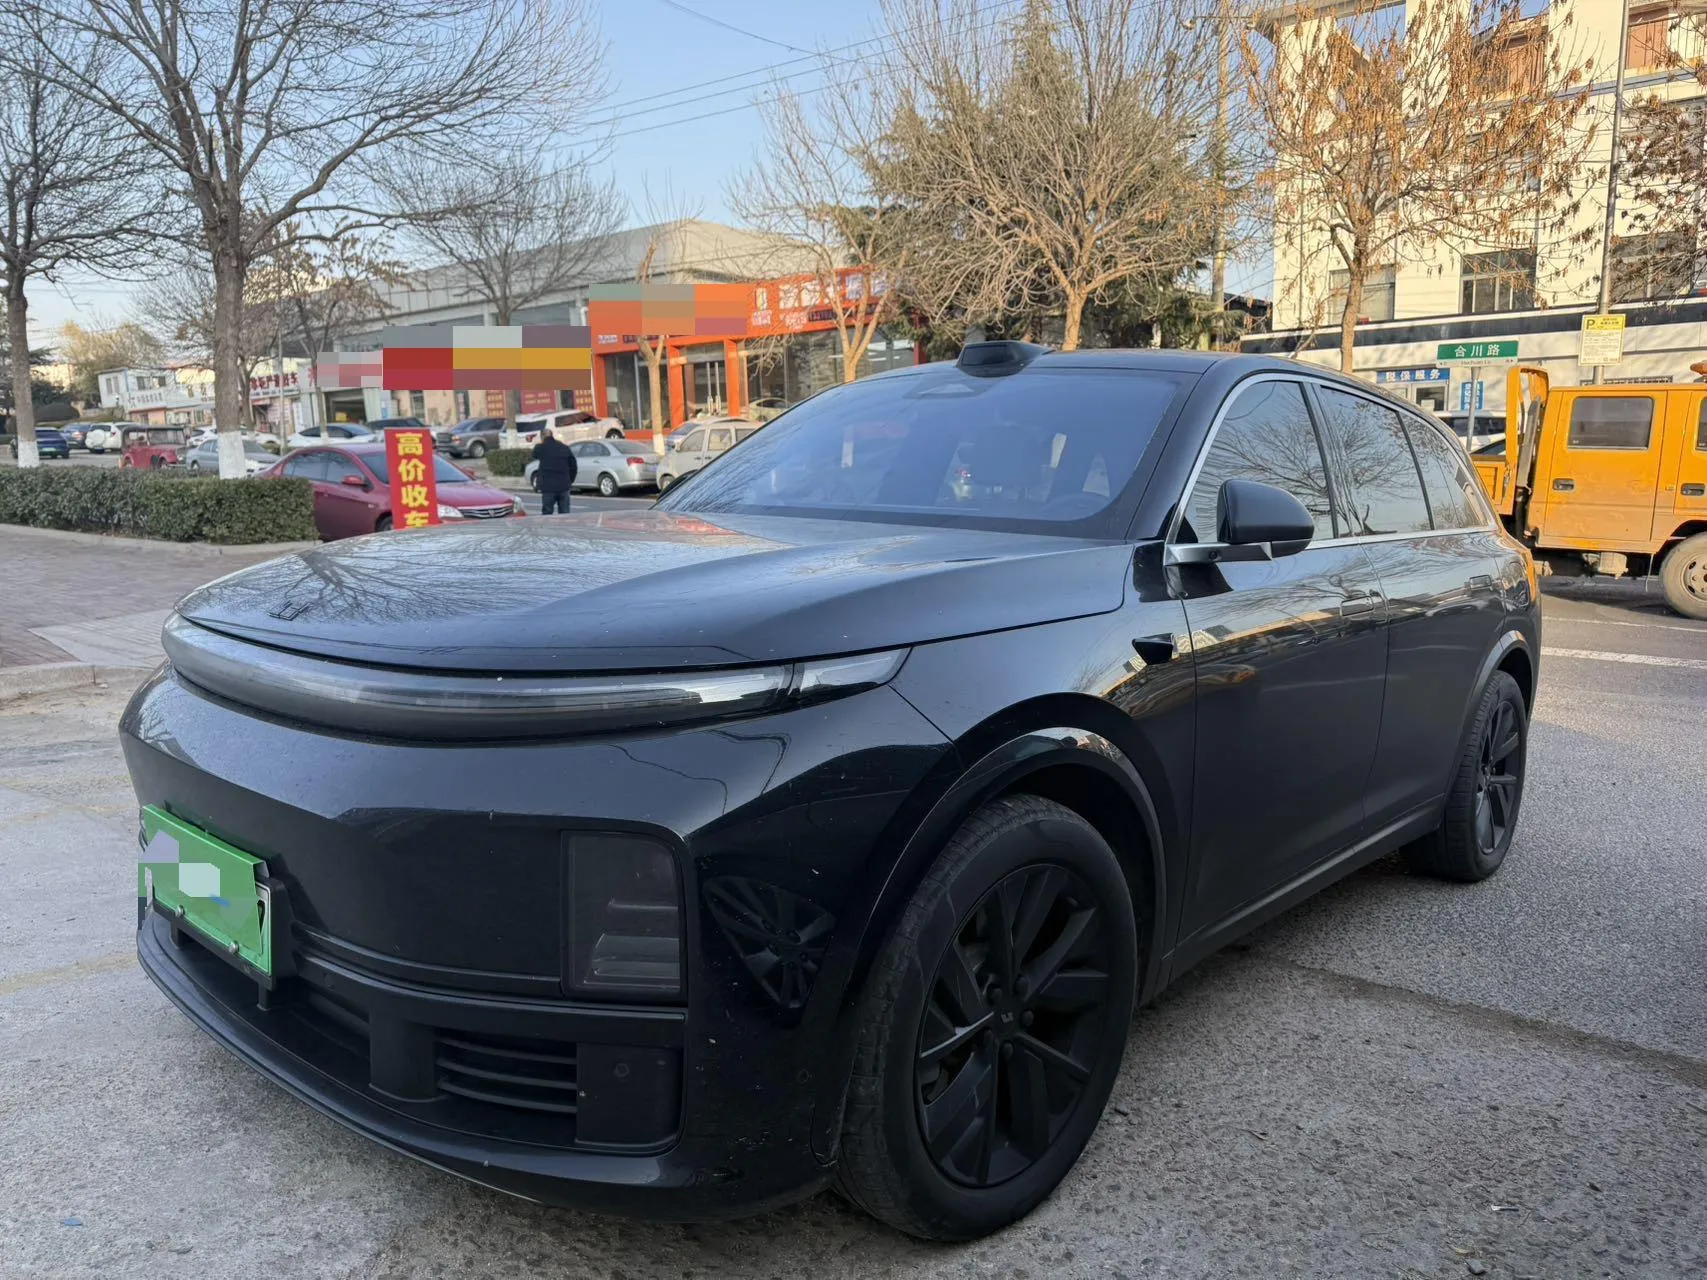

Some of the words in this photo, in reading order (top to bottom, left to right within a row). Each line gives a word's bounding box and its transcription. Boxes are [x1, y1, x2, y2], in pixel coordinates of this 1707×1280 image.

[1454, 344, 1500, 357] 合川路
[395, 432, 429, 529] 高价收车
